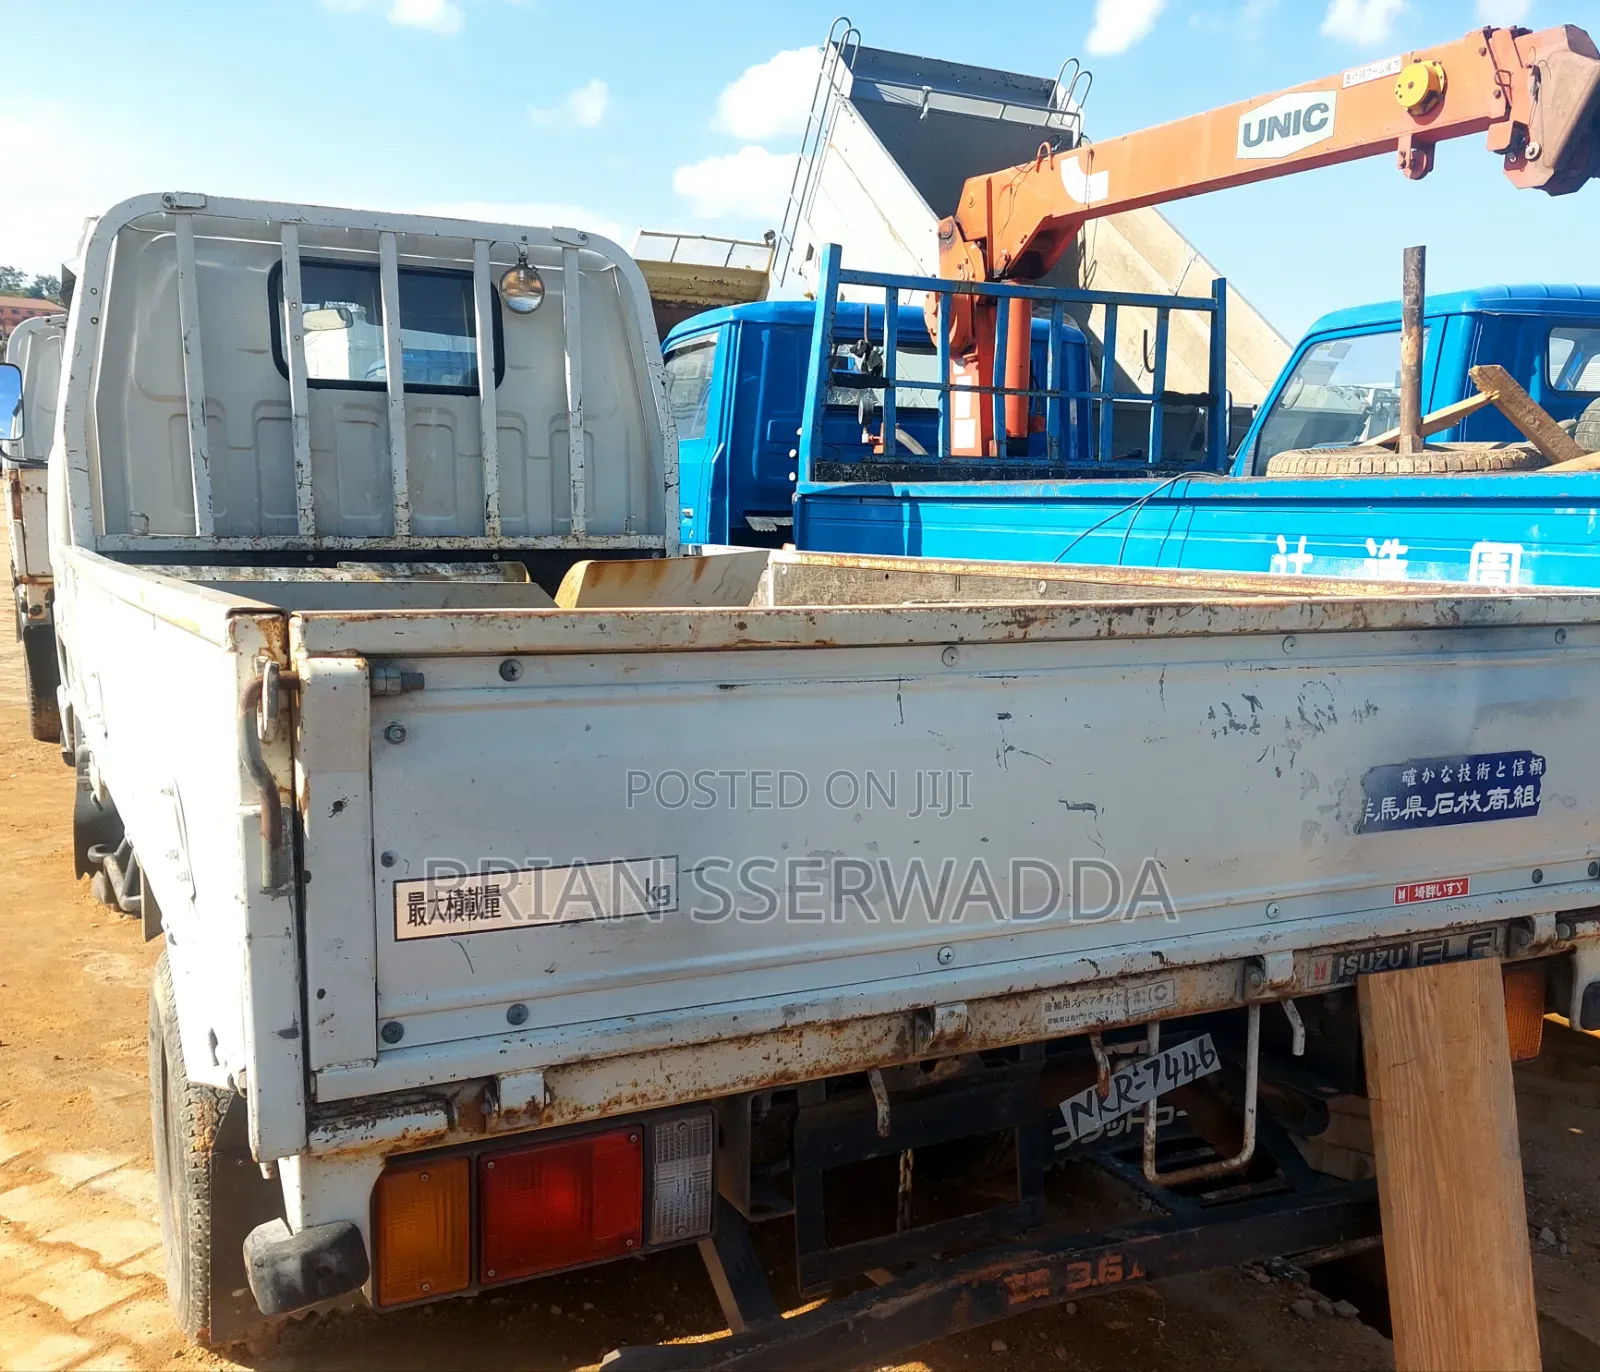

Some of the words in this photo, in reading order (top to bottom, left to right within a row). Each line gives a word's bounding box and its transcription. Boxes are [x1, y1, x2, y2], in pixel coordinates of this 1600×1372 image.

[1242, 102, 1329, 148] UNIC
[1401, 757, 1544, 788] 確かな技術と信頼
[1364, 784, 1541, 825] 馬県石材商組
[406, 883, 502, 928] 最大積載量
[645, 877, 671, 907] kg
[1339, 945, 1405, 978] ISUZU
[1416, 931, 1493, 967] ELF
